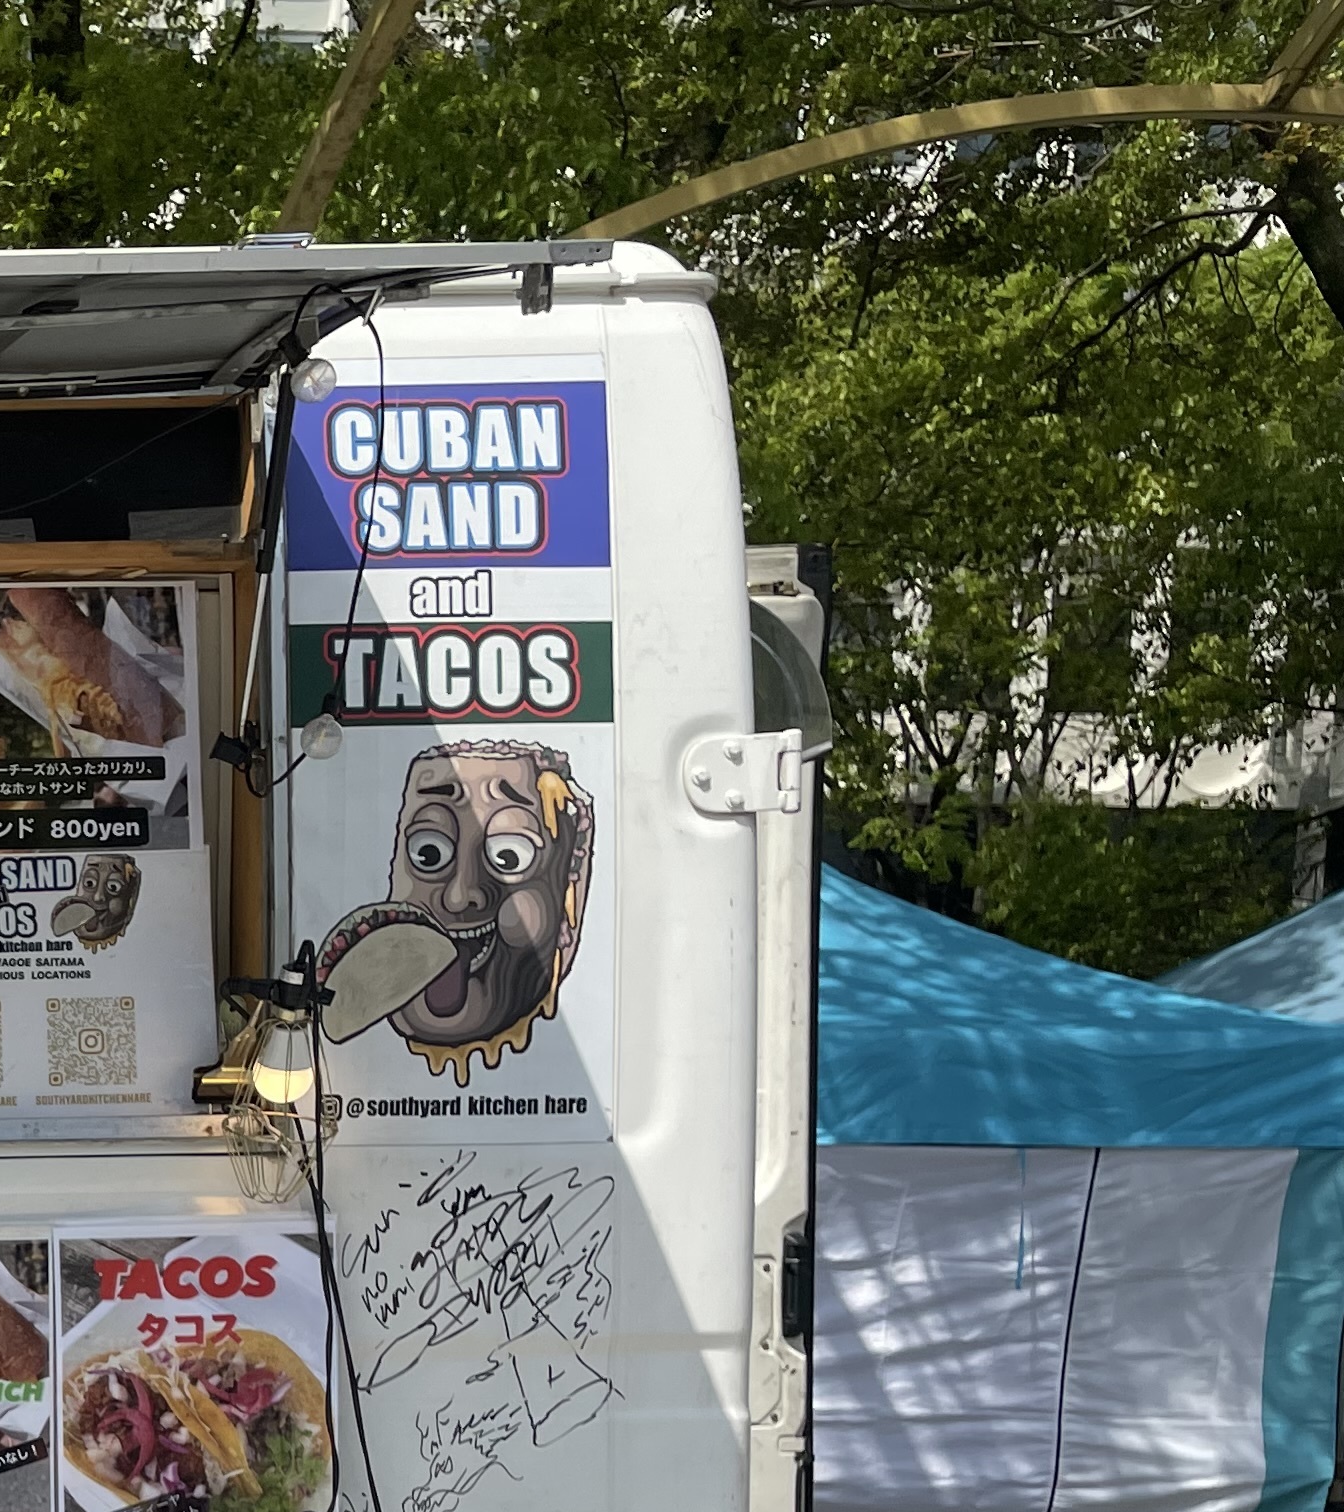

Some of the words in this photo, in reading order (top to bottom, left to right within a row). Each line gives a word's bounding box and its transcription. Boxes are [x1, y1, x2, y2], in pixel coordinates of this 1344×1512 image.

[330, 402, 562, 474] CUBAN
[358, 479, 542, 552] SAND
[410, 570, 492, 617] and
[329, 630, 574, 712] TACOS
[50, 818, 141, 844] 800yen
[1, 857, 76, 892] SAND
[0, 940, 43, 953] kitchen
[46, 939, 73, 951] hare
[35, 957, 84, 967] SAITAMA
[31, 969, 92, 980] LOCATIONS
[468, 1093, 538, 1115] kitchen
[545, 1093, 587, 1116] hare
[92, 1253, 280, 1301] TACOS
[136, 1312, 243, 1349] タコス
